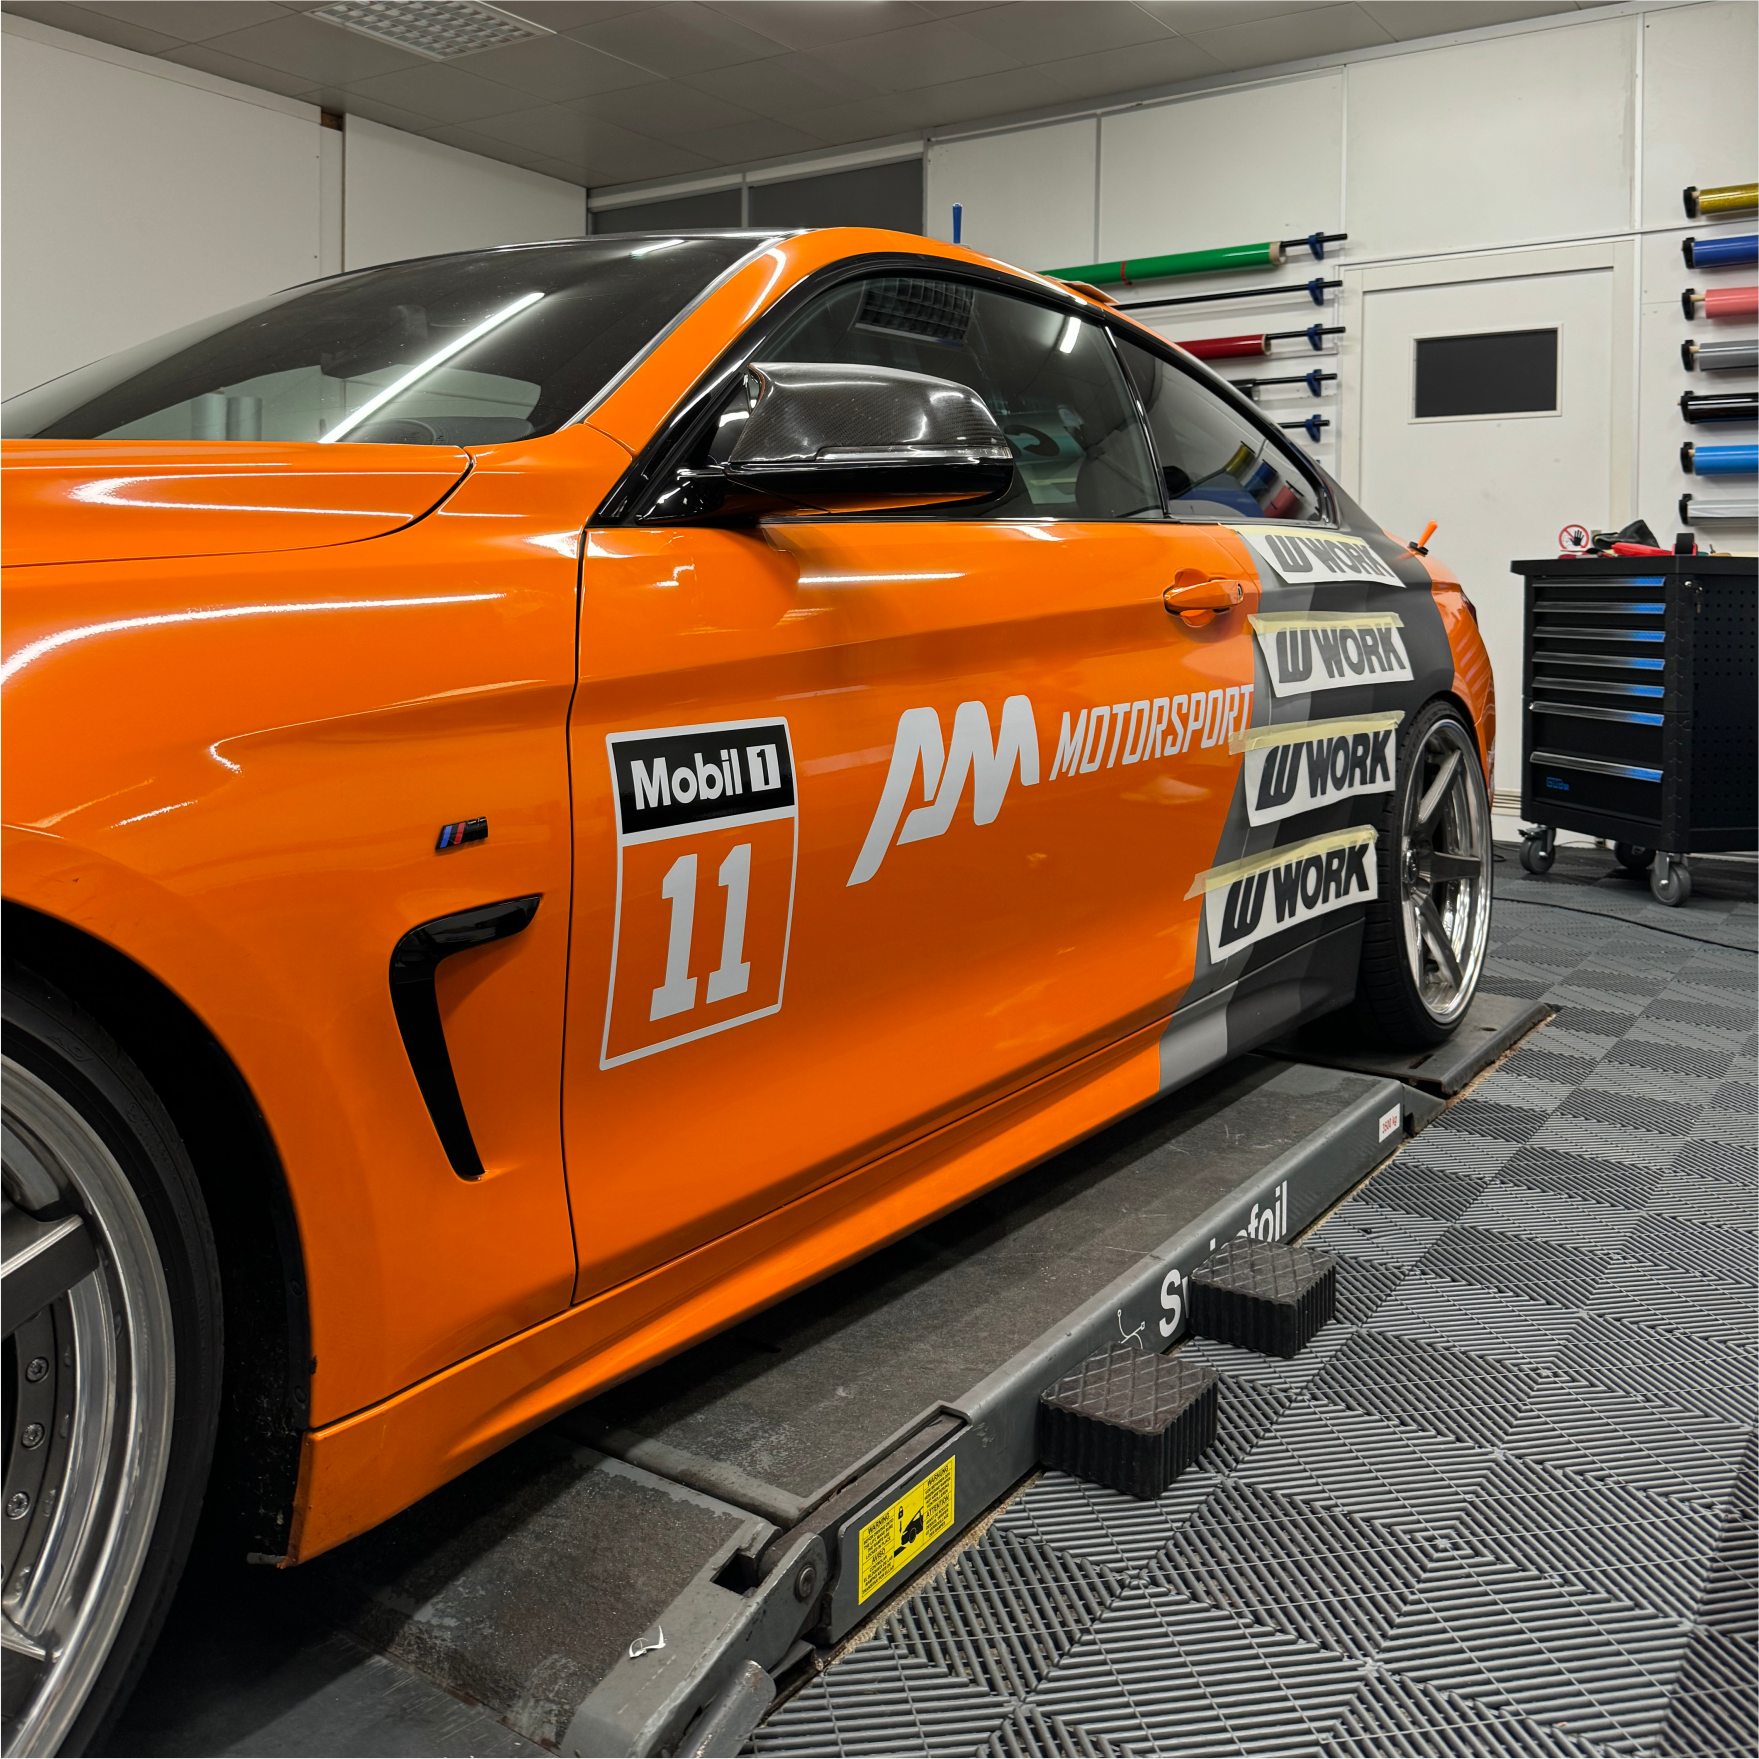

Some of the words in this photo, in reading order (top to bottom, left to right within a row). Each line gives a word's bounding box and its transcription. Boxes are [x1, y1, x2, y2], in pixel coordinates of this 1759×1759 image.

[1299, 537, 1396, 579] WORK
[1312, 623, 1407, 679] WORK
[1049, 684, 1254, 781] MOTORSPORT
[630, 748, 743, 811] Mobil
[1306, 729, 1391, 799] WORK
[1272, 837, 1371, 924] WORK
[650, 843, 752, 1022] 11
[868, 1512, 890, 1535] WARNING
[926, 1494, 949, 1518] ATTENTION
[872, 1547, 886, 1564] AVISO
